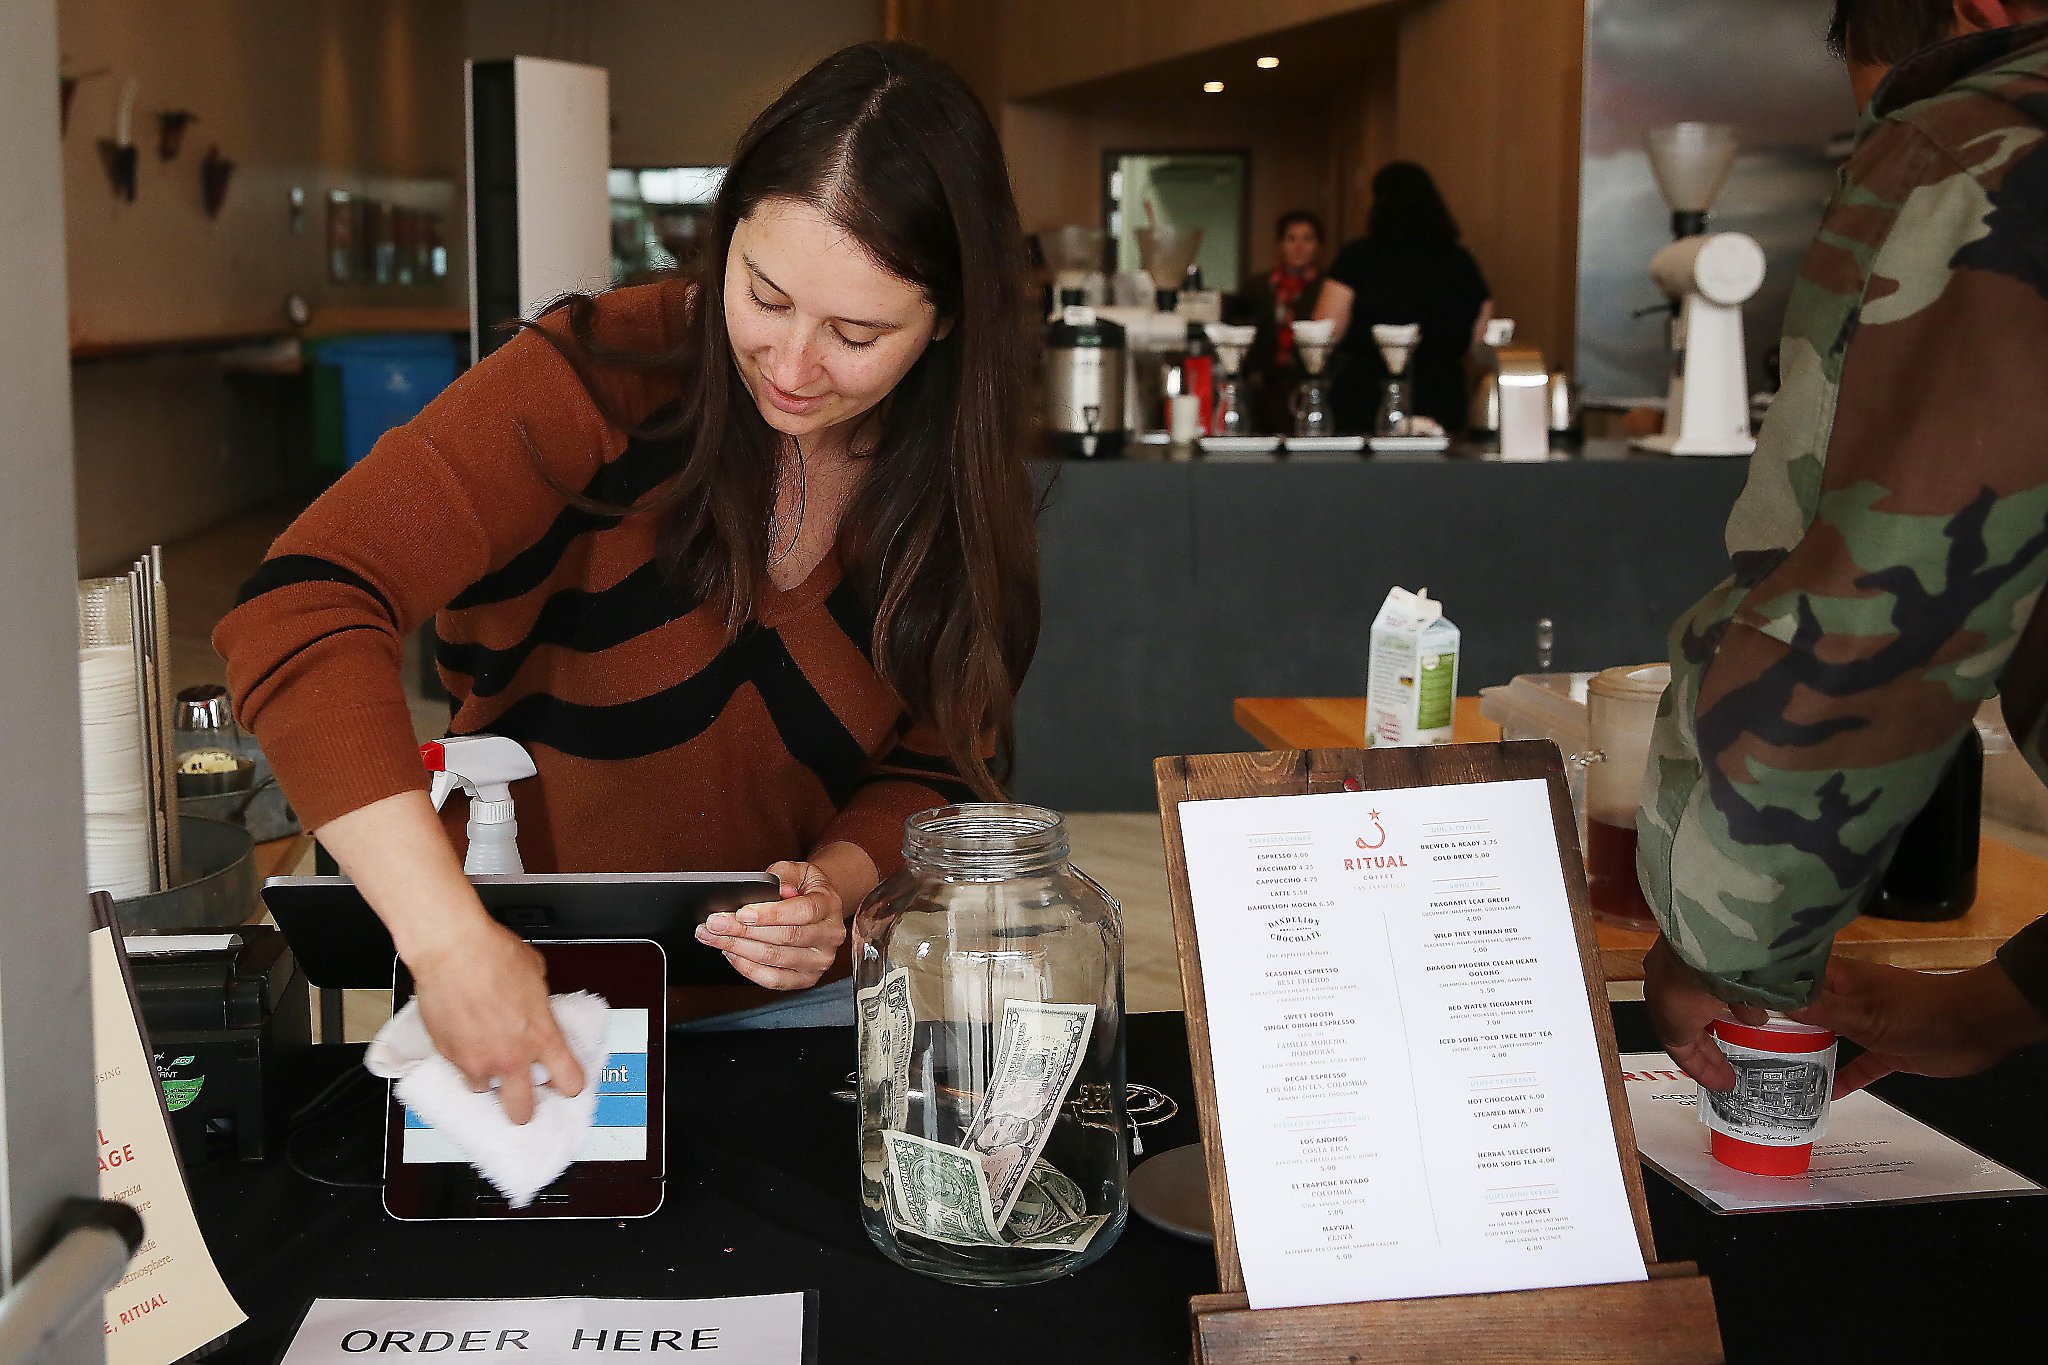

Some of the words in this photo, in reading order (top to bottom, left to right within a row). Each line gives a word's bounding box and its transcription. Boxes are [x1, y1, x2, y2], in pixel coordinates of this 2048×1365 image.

[1343, 855, 1408, 871] RITUAL
[1256, 865, 1297, 873] MACCHIATO
[1256, 878, 1302, 886] CAPPUCCINO
[1247, 903, 1289, 912] DANDELION
[1430, 900, 1467, 908] FRAGRANT
[1268, 916, 1320, 928] DANDELION
[1270, 930, 1322, 943] CHOCOLATE
[1426, 964, 1456, 972] DRAGON
[1264, 970, 1302, 978] SEASONAL
[1469, 970, 1500, 978] OOLONG
[1489, 1000, 1532, 1008] TIEGUANYIN
[1320, 1018, 1356, 1026] ESPRESSO
[598, 1064, 628, 1083] int
[1310, 1072, 1346, 1080] ESPRESSO
[1326, 1080, 1368, 1088] COLOMBIA
[1484, 1094, 1526, 1104] CHOCOLATE
[1474, 1110, 1506, 1118] STEAMED
[1478, 1150, 1506, 1158] HERBAL
[1508, 1147, 1551, 1156] SELECTIONS
[1302, 1180, 1337, 1188] TRAPICHE
[1340, 1177, 1370, 1185] RAYADO
[1312, 1188, 1353, 1197] COLOMBIA
[1526, 1208, 1551, 1216] JACKET
[1322, 1224, 1354, 1232] MAYWAL
[1327, 1234, 1354, 1242] KENYA
[140, 1239, 156, 1256] safe
[121, 1255, 174, 1286] atmosphere.
[119, 1293, 168, 1327] RITUAL
[339, 1329, 531, 1354] ORDER
[570, 1328, 721, 1352] HERE
